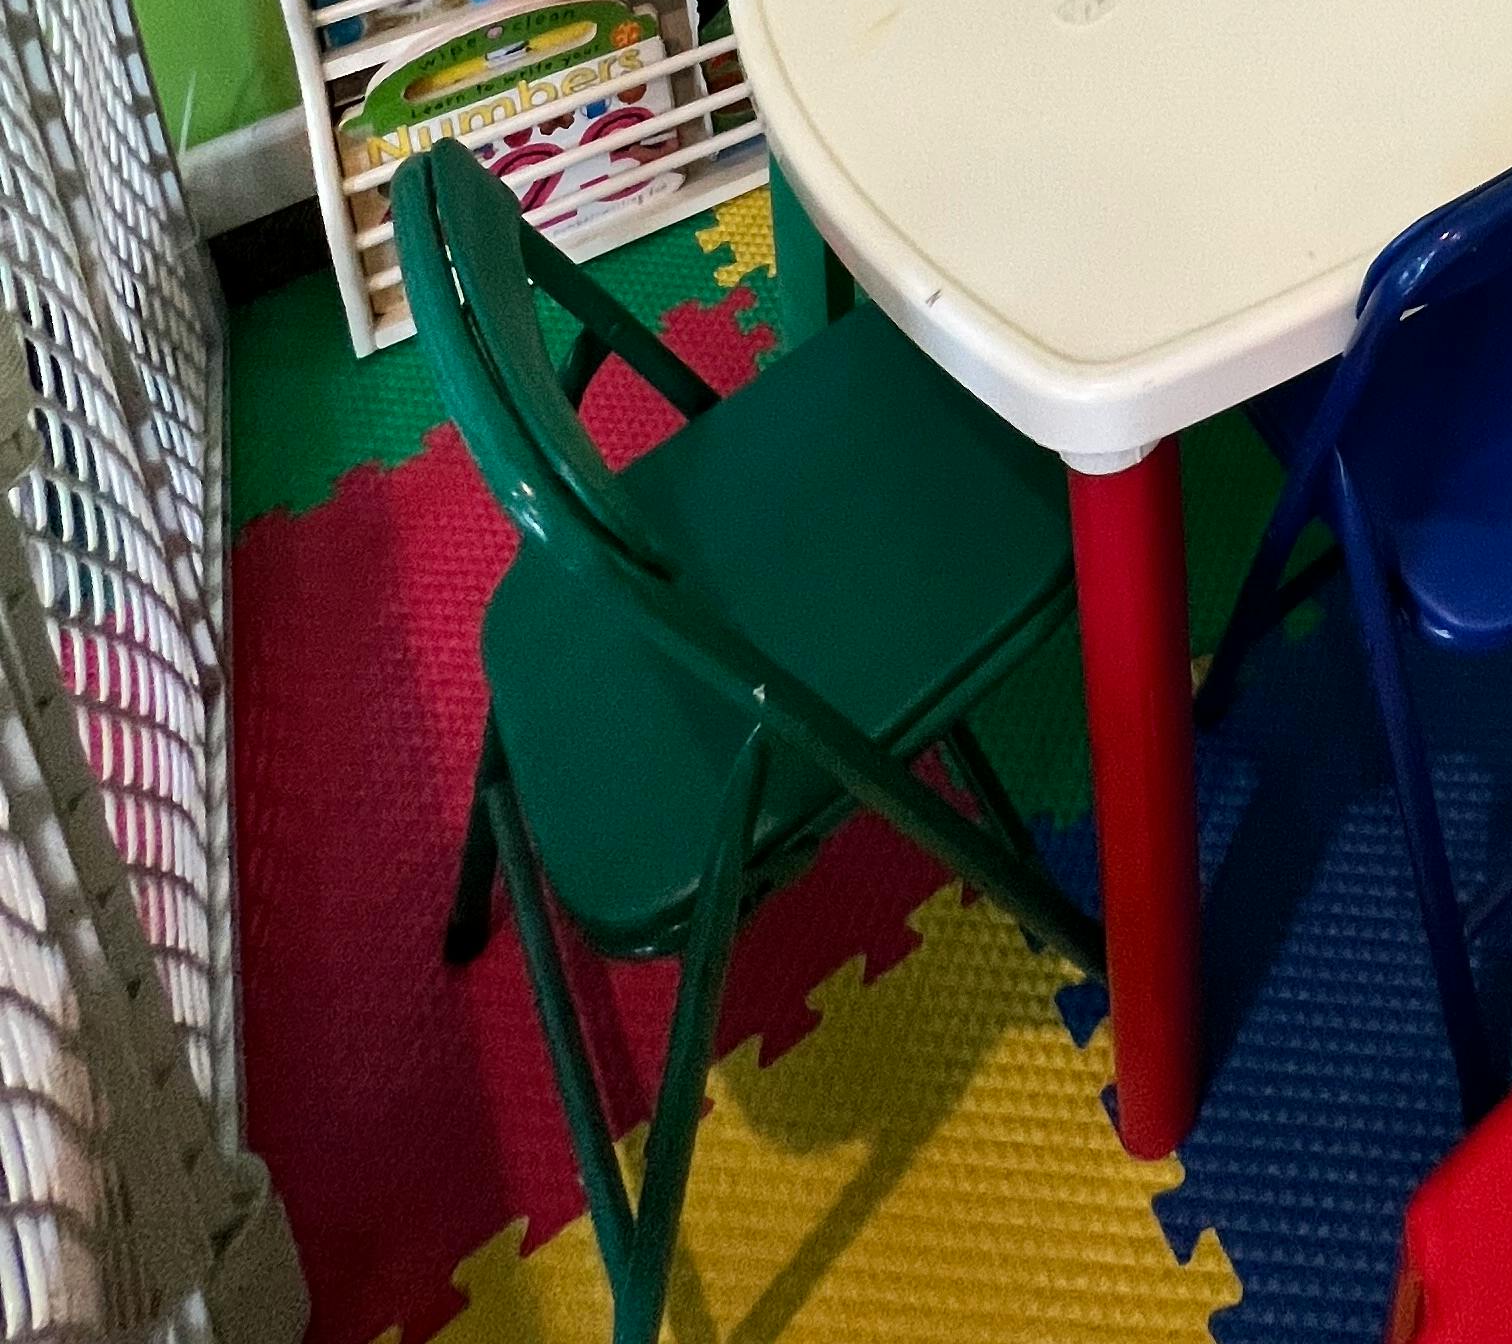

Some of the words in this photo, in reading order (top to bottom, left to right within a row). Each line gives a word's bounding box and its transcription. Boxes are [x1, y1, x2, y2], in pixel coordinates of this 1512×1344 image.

[419, 37, 476, 71] wipe
[512, 9, 576, 33] clean
[412, 95, 461, 118] Learn
[476, 81, 493, 96] to
[502, 60, 553, 84] write
[563, 43, 600, 66] your
